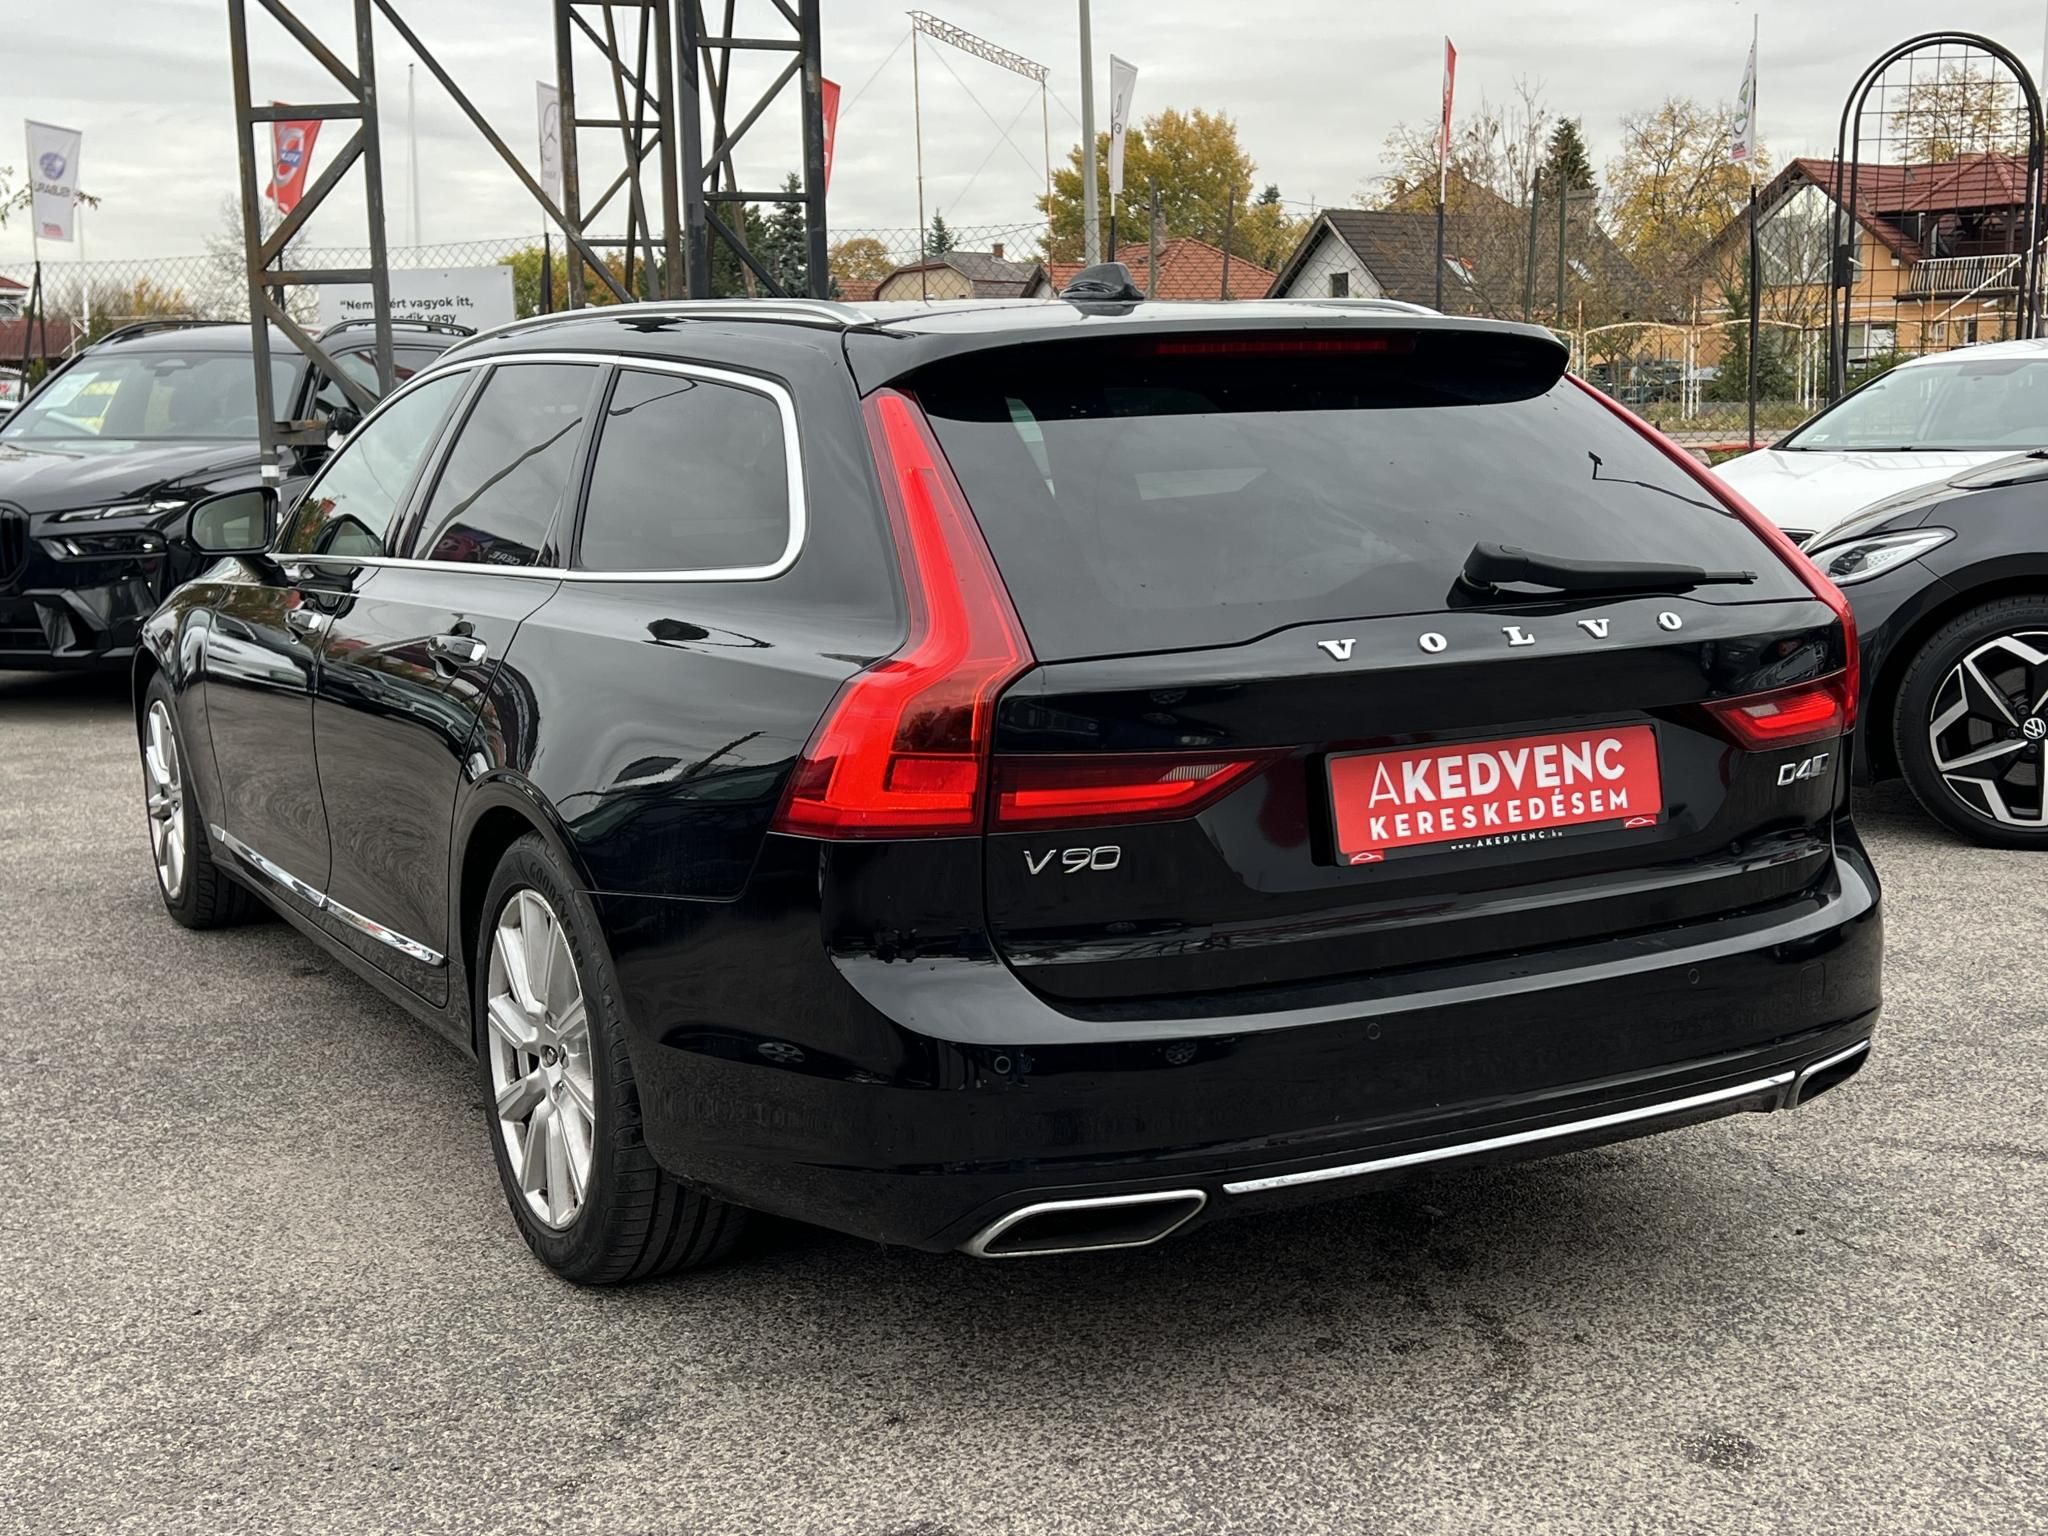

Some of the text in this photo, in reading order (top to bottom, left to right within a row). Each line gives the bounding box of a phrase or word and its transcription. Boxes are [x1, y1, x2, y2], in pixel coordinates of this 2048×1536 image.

[410, 298, 453, 310] vagyok
[457, 296, 474, 308] itt,
[1318, 611, 1683, 661] VOLVO
[1368, 738, 1626, 809] AKEDVENC
[1369, 787, 1629, 841] KERESKEDÉSEM
